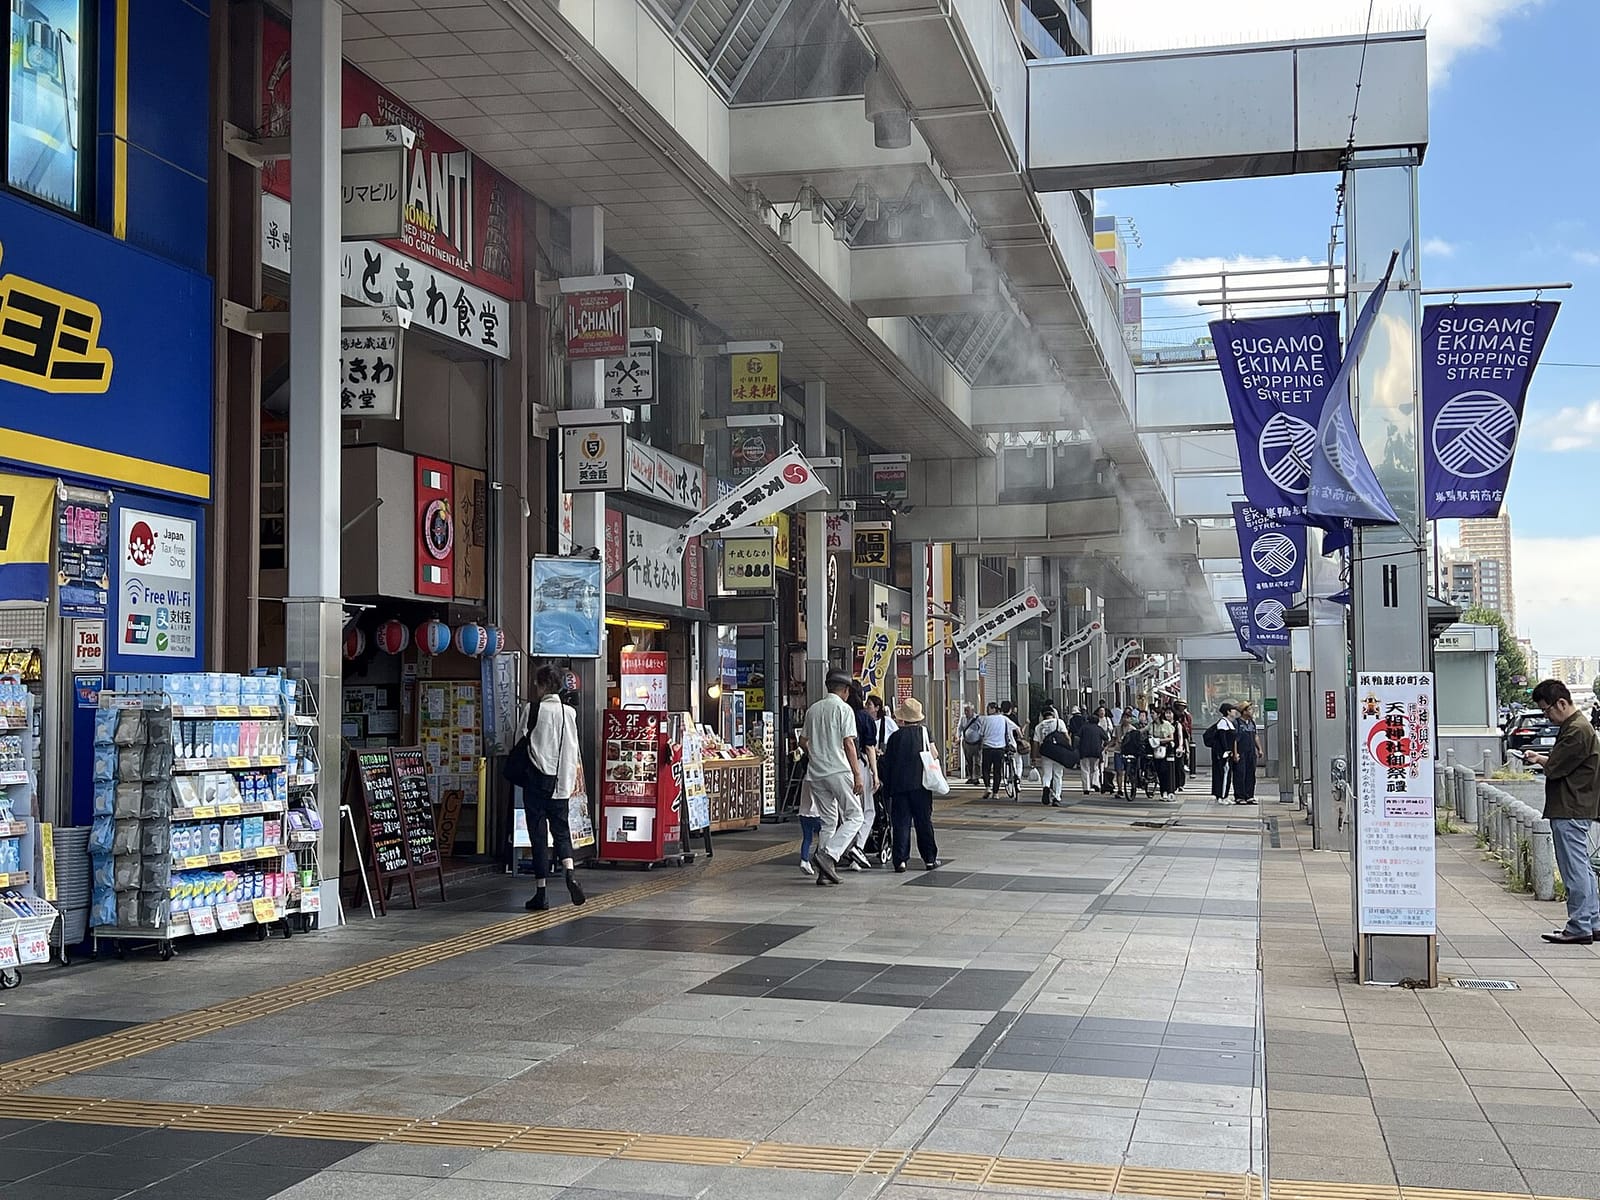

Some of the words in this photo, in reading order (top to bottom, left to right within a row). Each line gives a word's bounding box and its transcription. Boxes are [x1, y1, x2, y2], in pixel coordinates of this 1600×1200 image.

[341, 183, 397, 204] リマビル
[419, 230, 436, 246] 1972
[415, 237, 470, 272] CONTINENTALE
[362, 247, 500, 348] ときわ食堂
[1231, 334, 1324, 357] SUGAMO
[1437, 334, 1533, 354] EKIMAE
[1237, 354, 1325, 375] EKIMAE
[1436, 352, 1529, 367] SHOPPING
[1446, 366, 1516, 380] STREET
[579, 461, 608, 470] シェーン
[579, 470, 608, 480] 英会話
[855, 533, 885, 563] 鰻
[169, 556, 186, 569] Shop
[144, 587, 166, 605] Free
[167, 589, 191, 607] Wi-Fi
[79, 631, 99, 645] Tax
[76, 645, 102, 657] Free
[626, 713, 640, 726] 2F
